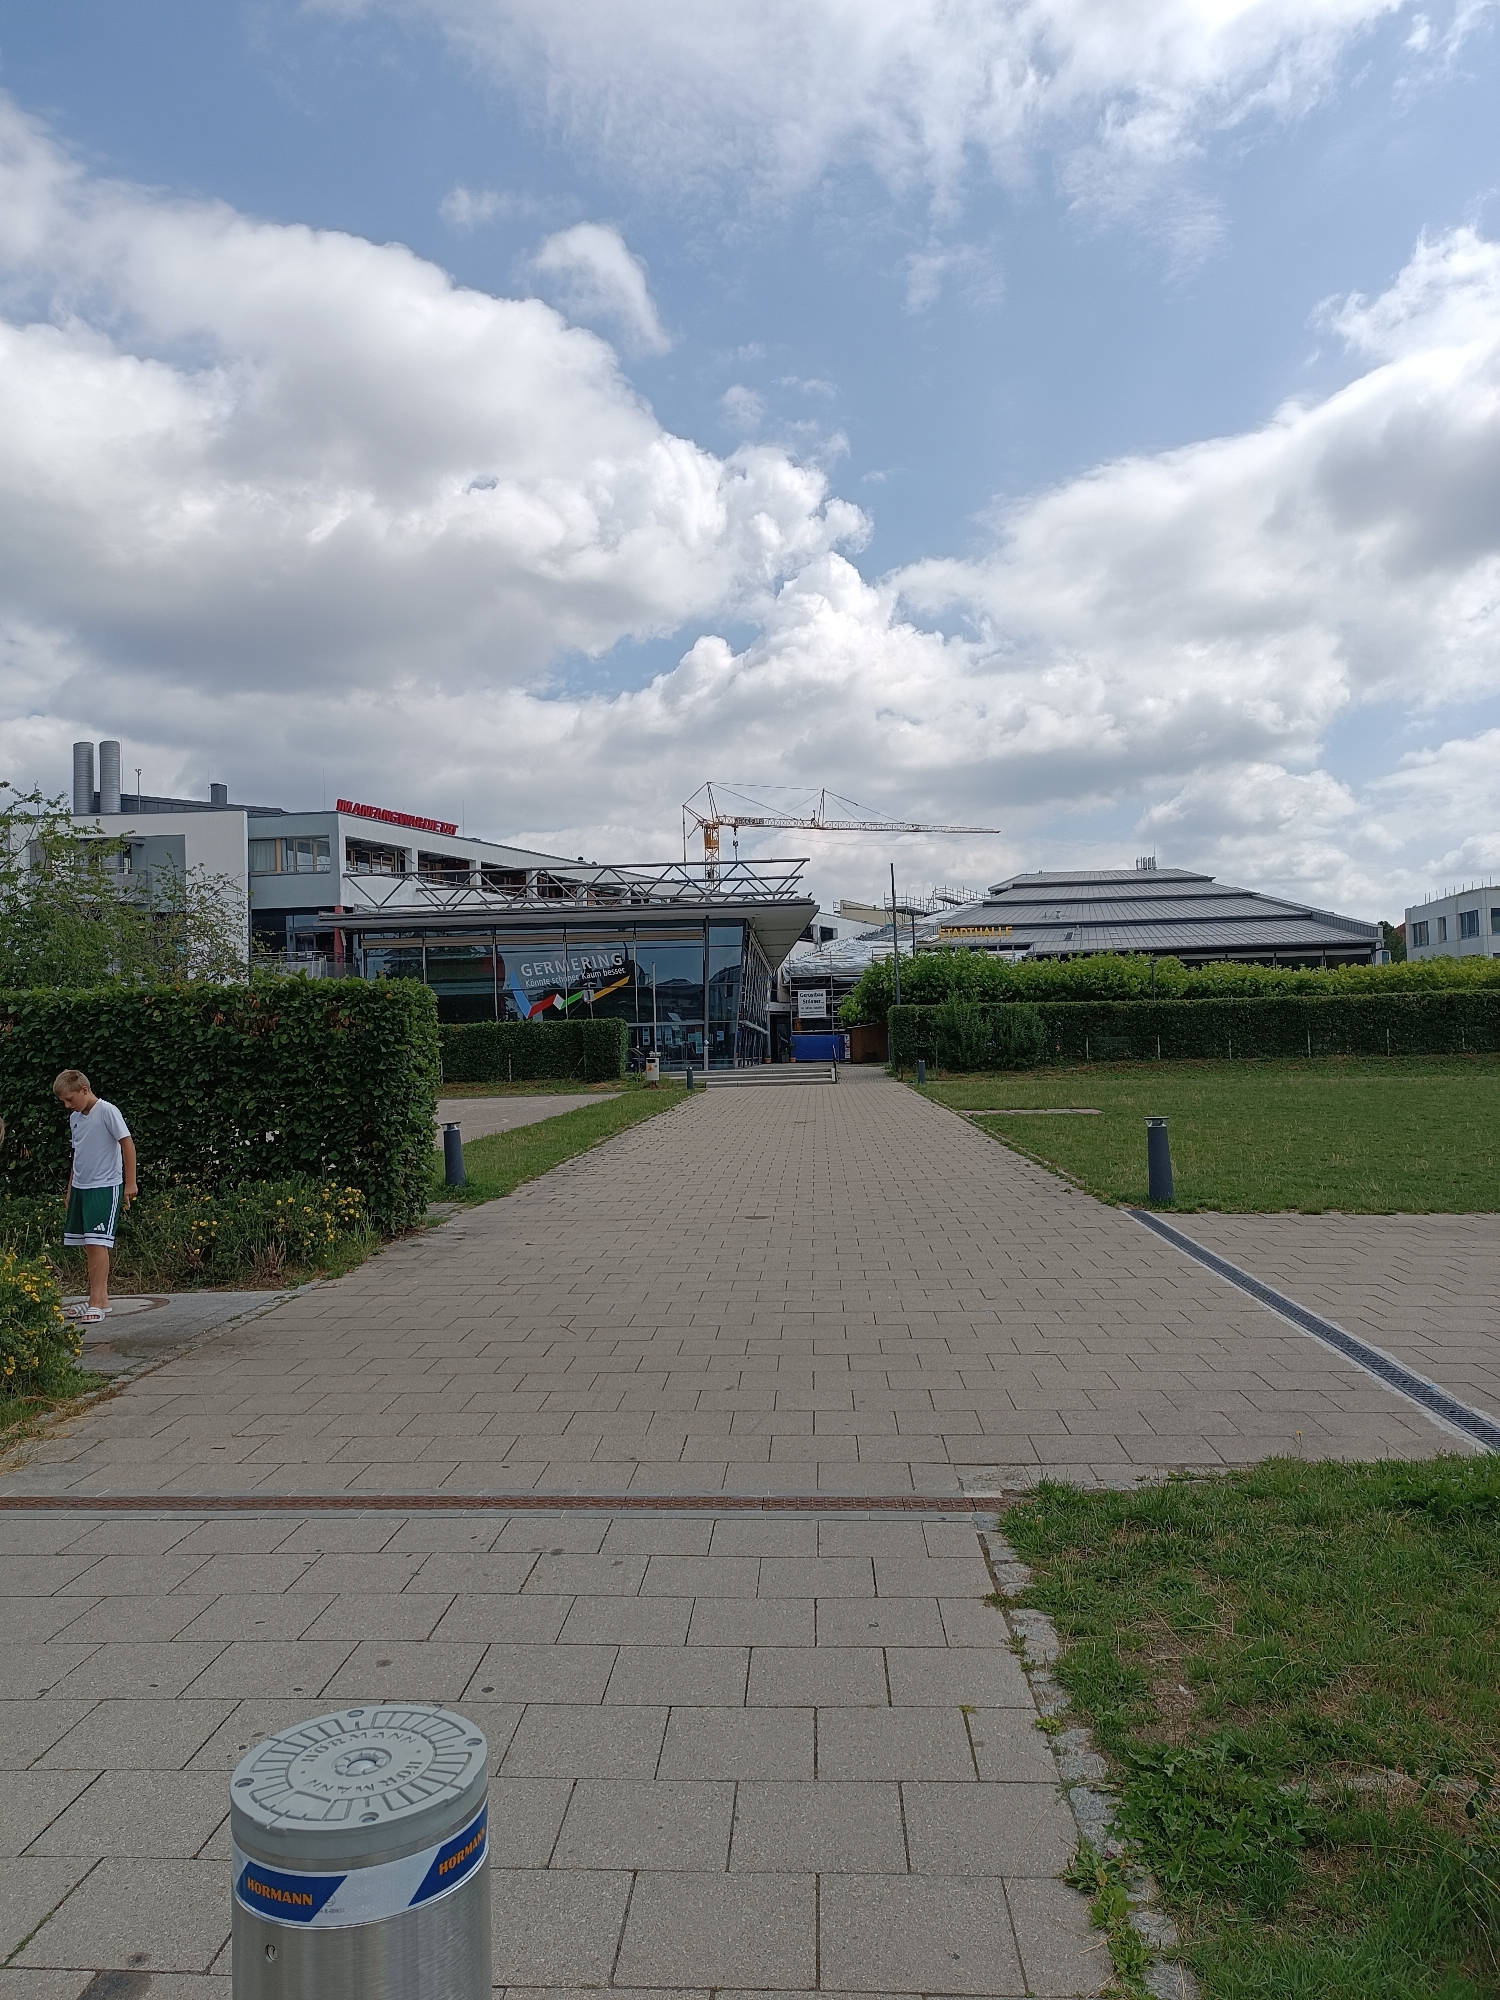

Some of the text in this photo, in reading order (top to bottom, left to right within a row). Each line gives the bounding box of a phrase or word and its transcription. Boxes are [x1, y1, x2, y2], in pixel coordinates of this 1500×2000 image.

[939, 926, 1013, 938] STADTHALLE
[521, 952, 623, 976] GERMERING
[525, 977, 551, 988] Könnte
[581, 970, 602, 980] Kaum
[246, 1876, 313, 1906] HÖRMANN
